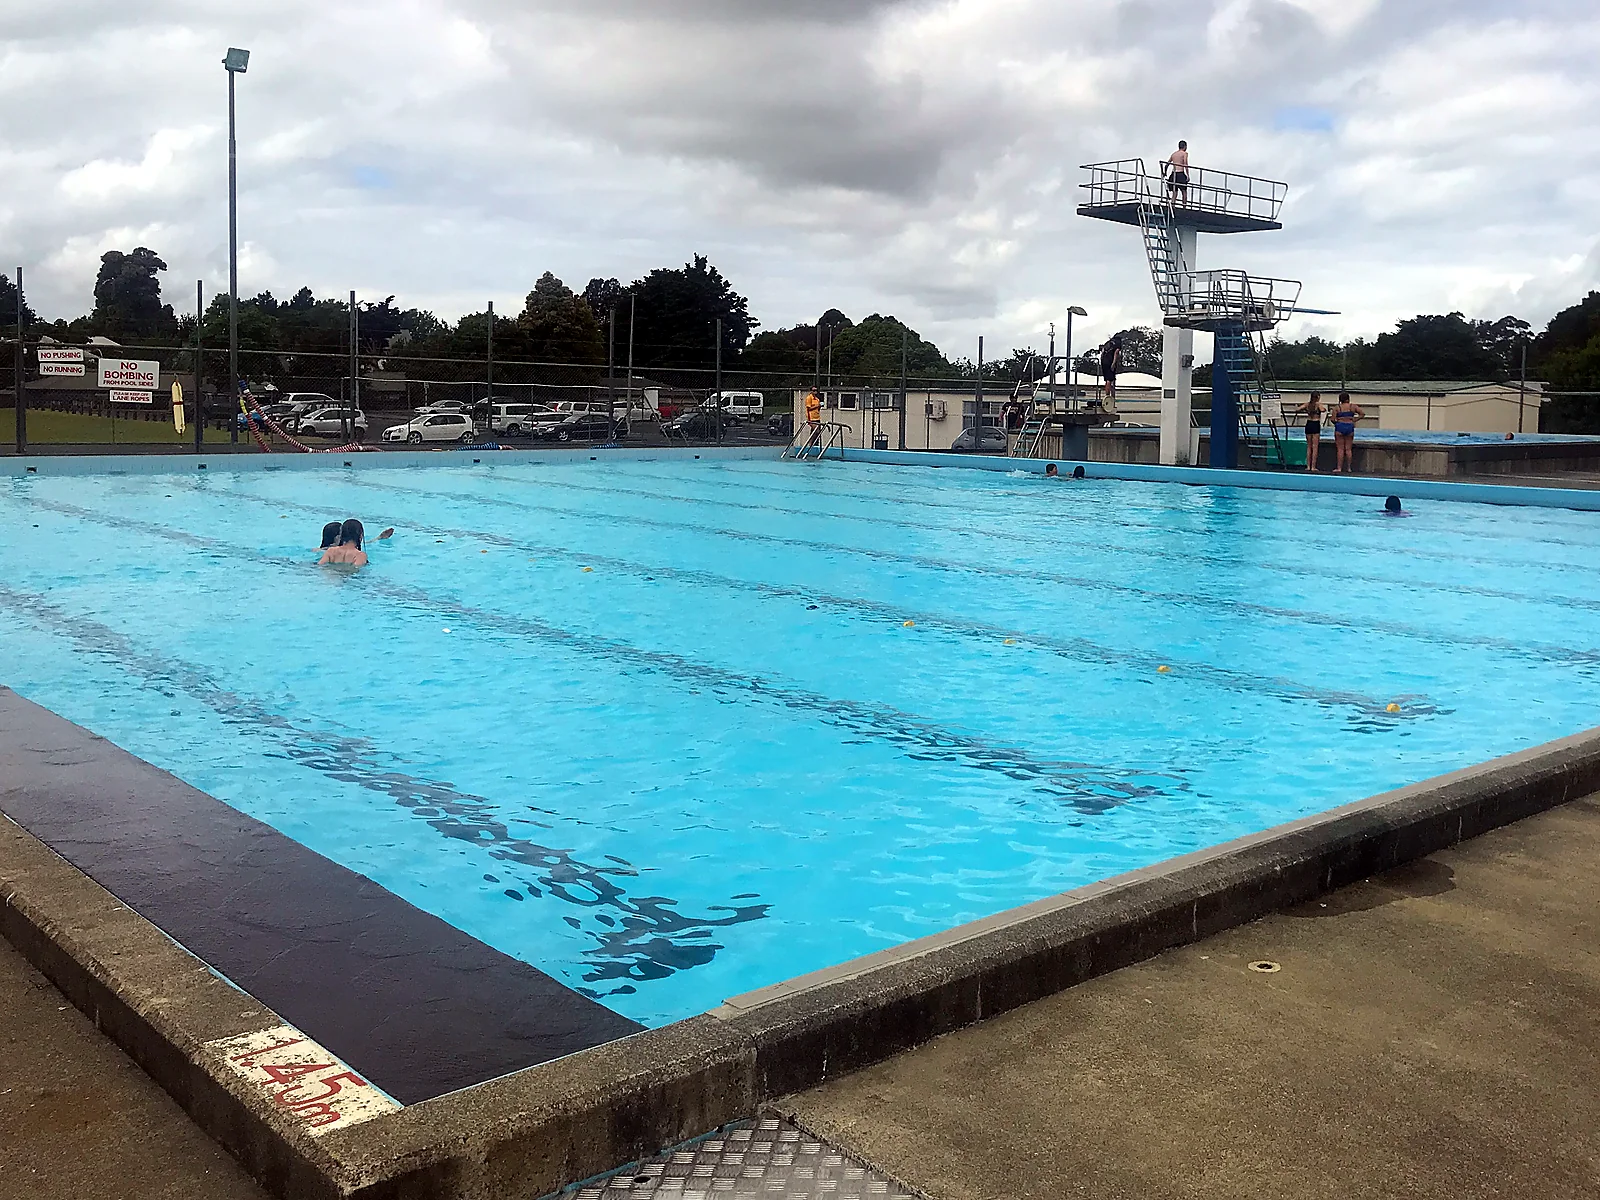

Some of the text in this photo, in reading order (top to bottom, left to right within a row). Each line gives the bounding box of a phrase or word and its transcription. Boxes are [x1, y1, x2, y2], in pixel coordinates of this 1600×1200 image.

[54, 366, 83, 374] RUNNING
[120, 361, 138, 370] NO
[104, 370, 154, 381] BOMBING
[230, 1037, 368, 1128] 1.45m
